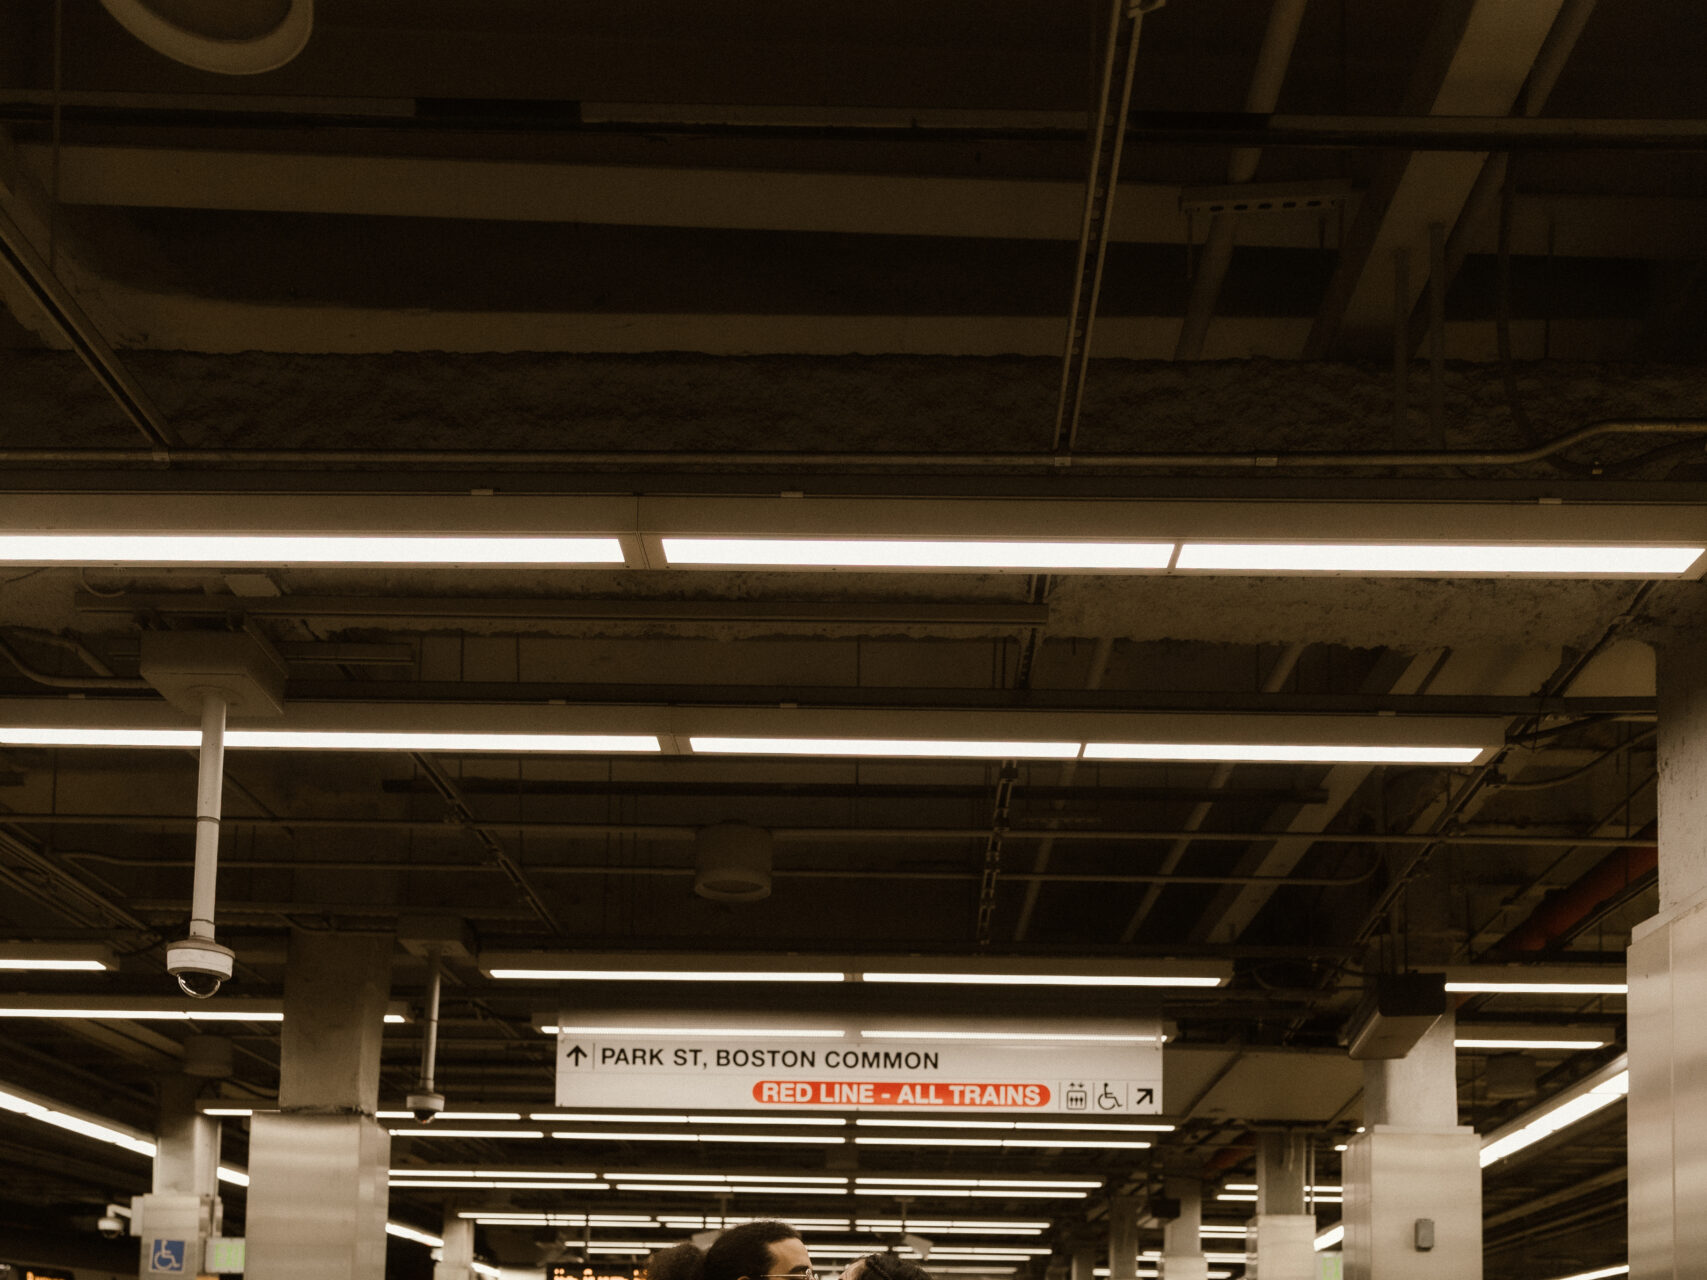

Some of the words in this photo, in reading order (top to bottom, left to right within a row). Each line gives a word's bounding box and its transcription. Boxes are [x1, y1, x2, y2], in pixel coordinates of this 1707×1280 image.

[601, 1047, 665, 1066] PARK
[673, 1048, 707, 1070] ST,
[716, 1049, 816, 1068] BOSTON
[825, 1050, 939, 1070] COMMON
[762, 1083, 813, 1103] RED
[820, 1084, 875, 1104] LINE
[897, 1084, 944, 1105] ALL
[949, 1085, 1041, 1106] TRAINS
